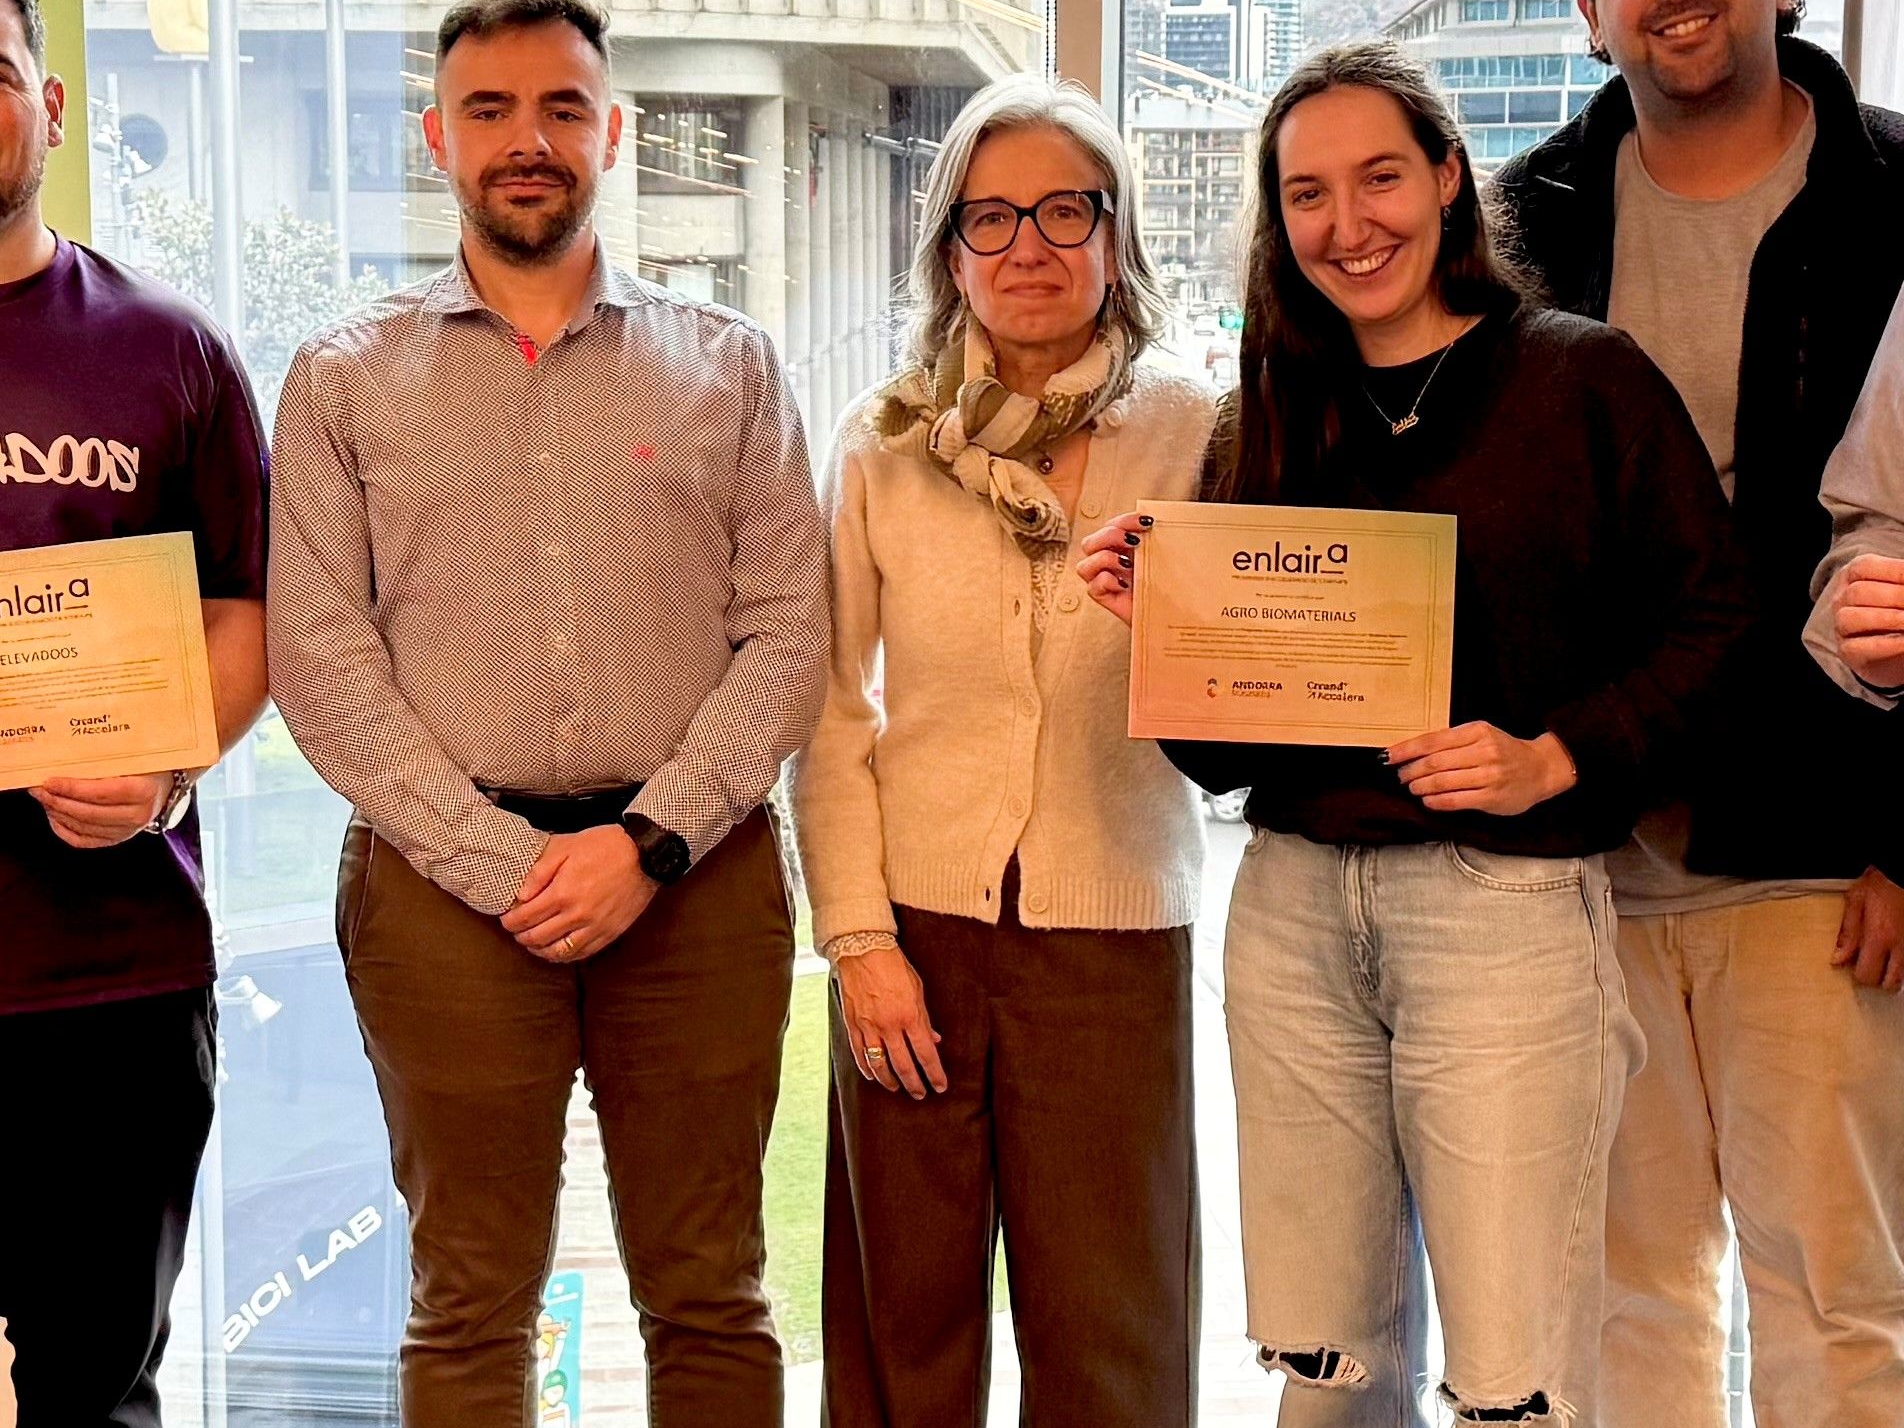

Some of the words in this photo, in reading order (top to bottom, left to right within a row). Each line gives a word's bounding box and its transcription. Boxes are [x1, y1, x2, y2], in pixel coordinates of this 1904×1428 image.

[1221, 606, 1258, 619] AGRO
[1261, 607, 1357, 623] BIOMATERIALS
[0, 646, 79, 666] ELEVADOOS
[296, 1205, 383, 1282] LAB
